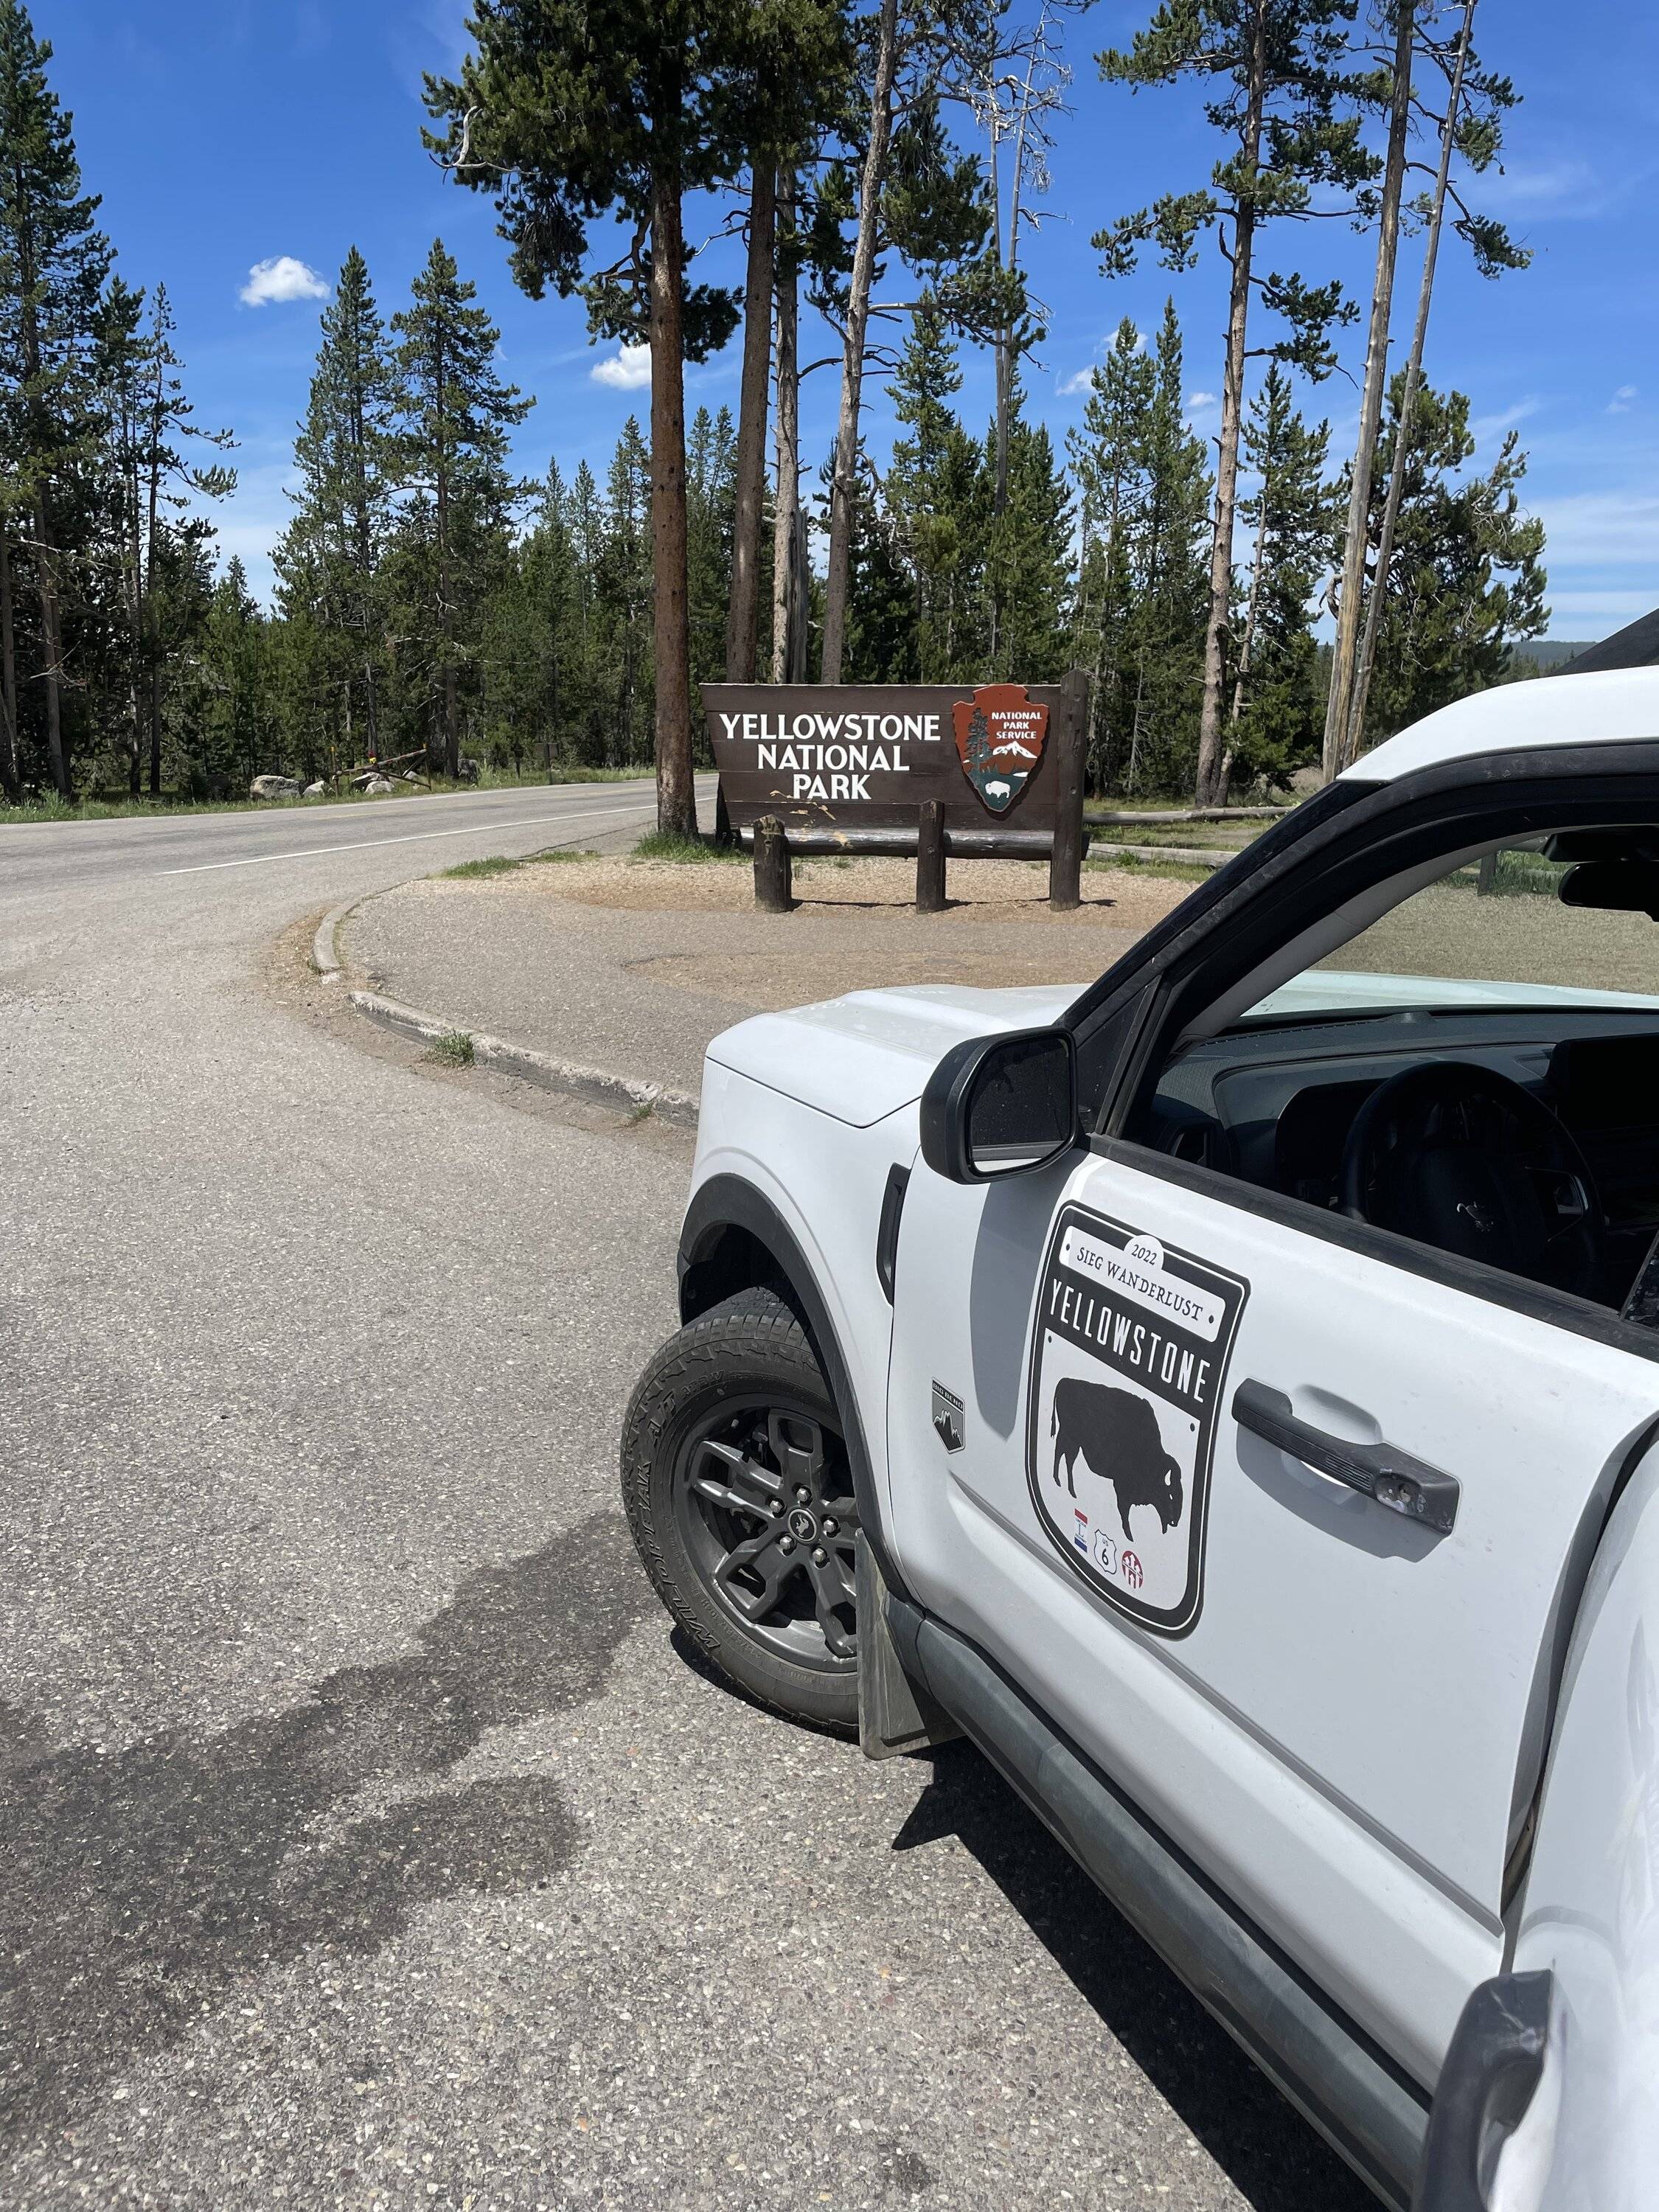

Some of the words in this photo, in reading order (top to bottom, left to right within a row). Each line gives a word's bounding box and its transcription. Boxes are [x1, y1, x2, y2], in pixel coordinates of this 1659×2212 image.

[718, 713, 942, 742] YELLOWSTONE
[991, 712, 1043, 720] NATIONAL
[1004, 721, 1029, 729] PARK
[996, 731, 1037, 740] SERVICE
[757, 744, 910, 772] NATIONAL
[793, 773, 872, 800] PARK
[1131, 1244, 1158, 1266] 2022
[1077, 1246, 1103, 1271] SIEG
[1107, 1260, 1203, 1321] WANDERLUST
[1049, 1278, 1211, 1403] YELLOWSTONE
[933, 1382, 944, 1395] BIG
[945, 1391, 963, 1409] BEND
[1102, 1548, 1109, 1565] 6
